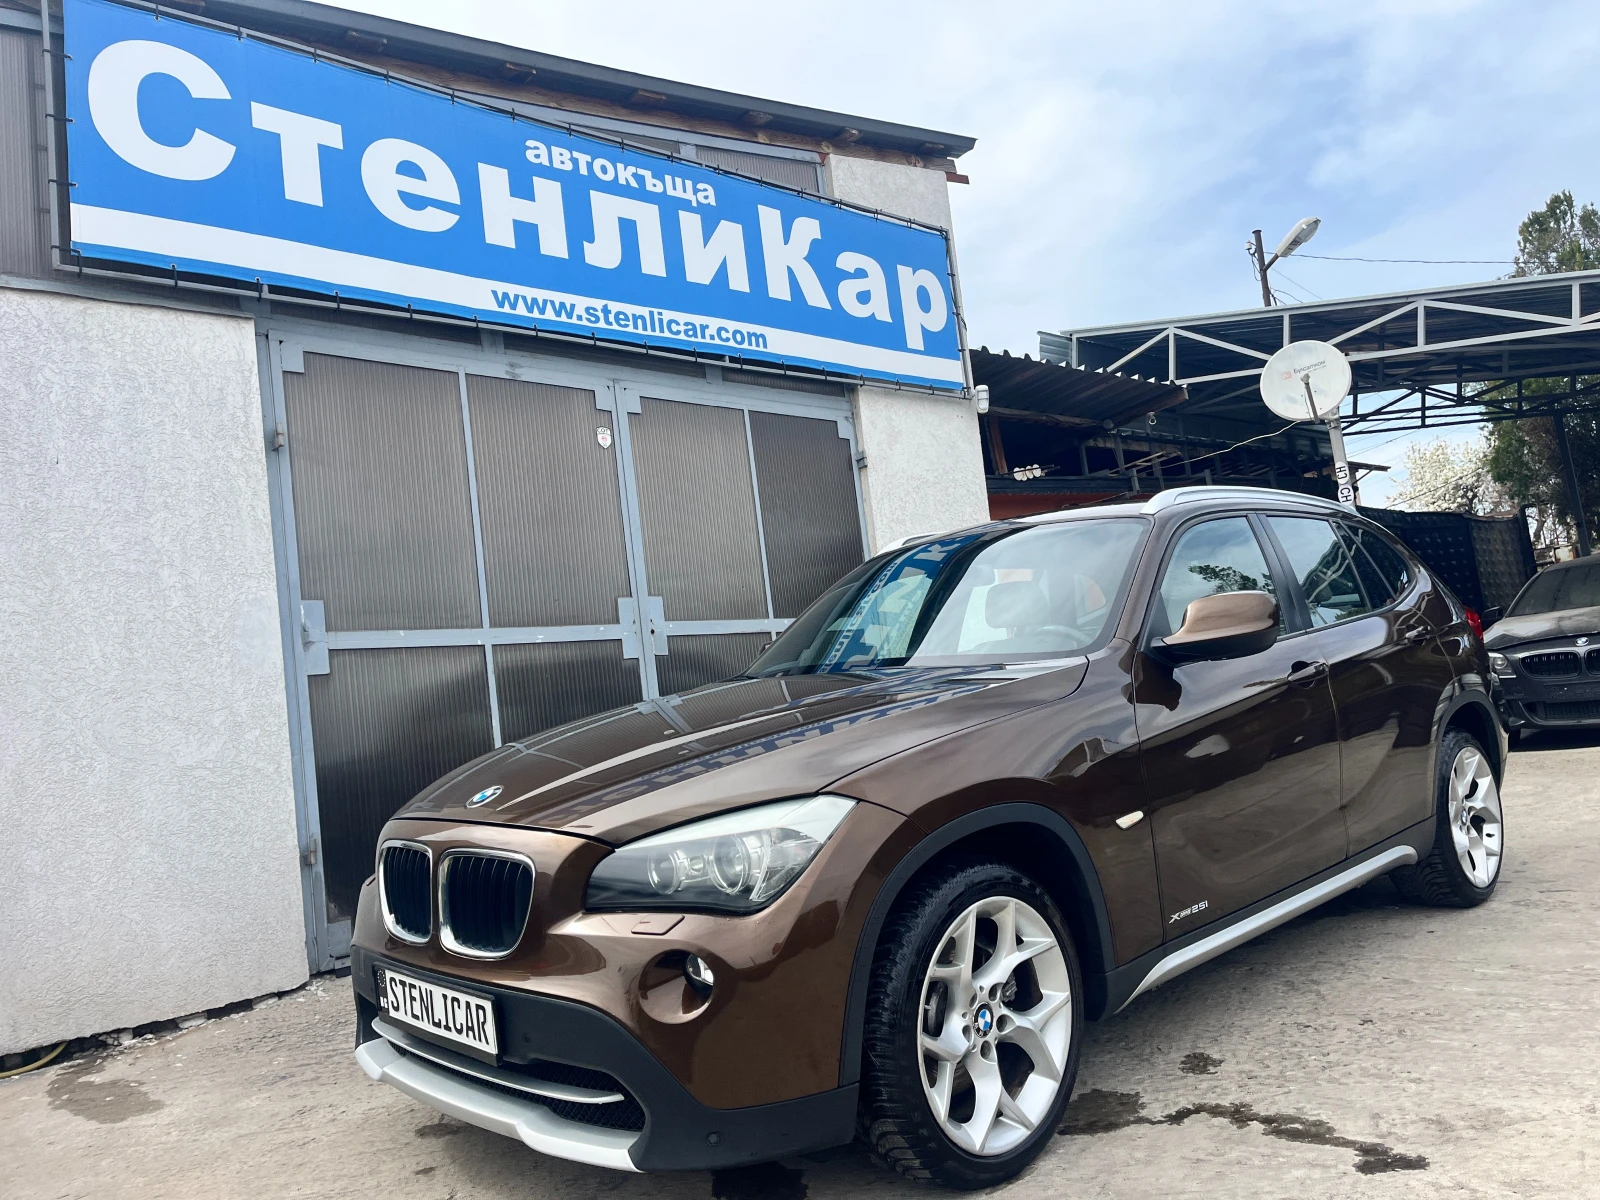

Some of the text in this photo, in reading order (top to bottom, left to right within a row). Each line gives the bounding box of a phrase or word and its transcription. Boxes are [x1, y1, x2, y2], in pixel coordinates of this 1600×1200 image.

[87, 39, 948, 351] СтенлиКар
[525, 139, 716, 207] автокъща
[491, 289, 768, 349] www.stenlicar.com
[389, 976, 490, 1047] STENLICAR
